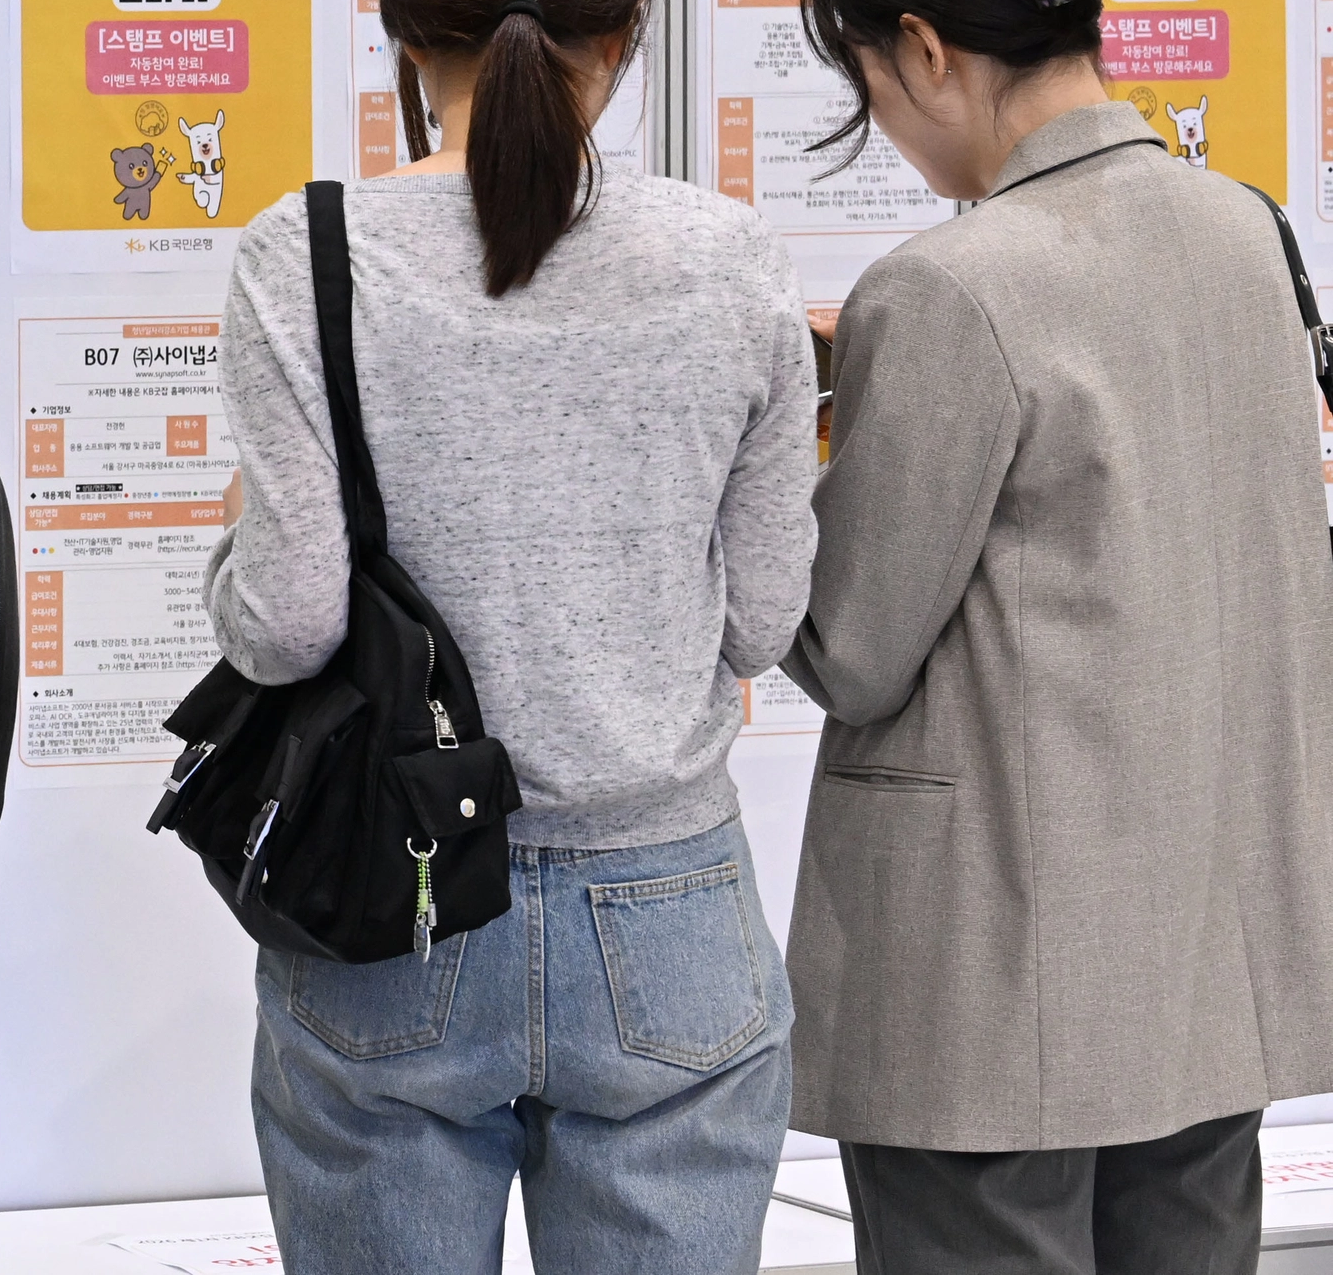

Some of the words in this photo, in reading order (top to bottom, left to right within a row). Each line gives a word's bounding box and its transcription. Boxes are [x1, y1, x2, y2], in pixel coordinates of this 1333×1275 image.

[1158, 17, 1216, 40] 이벤트]
[99, 29, 163, 53] [스탬프
[170, 28, 233, 52] 이벤트]
[1122, 45, 1161, 59] 자동참여
[1165, 44, 1189, 59] 완료!
[131, 57, 173, 71] 자동참여
[177, 56, 203, 71] 완료!
[1130, 61, 1151, 75] 부스
[1153, 60, 1214, 75] 방문해주세요
[102, 73, 137, 88] 이벤트
[139, 73, 162, 87] 부스
[165, 73, 230, 87] 방문해주세요
[85, 348, 119, 365] B07
[135, 369, 207, 380] www.synapsoft.co.kr
